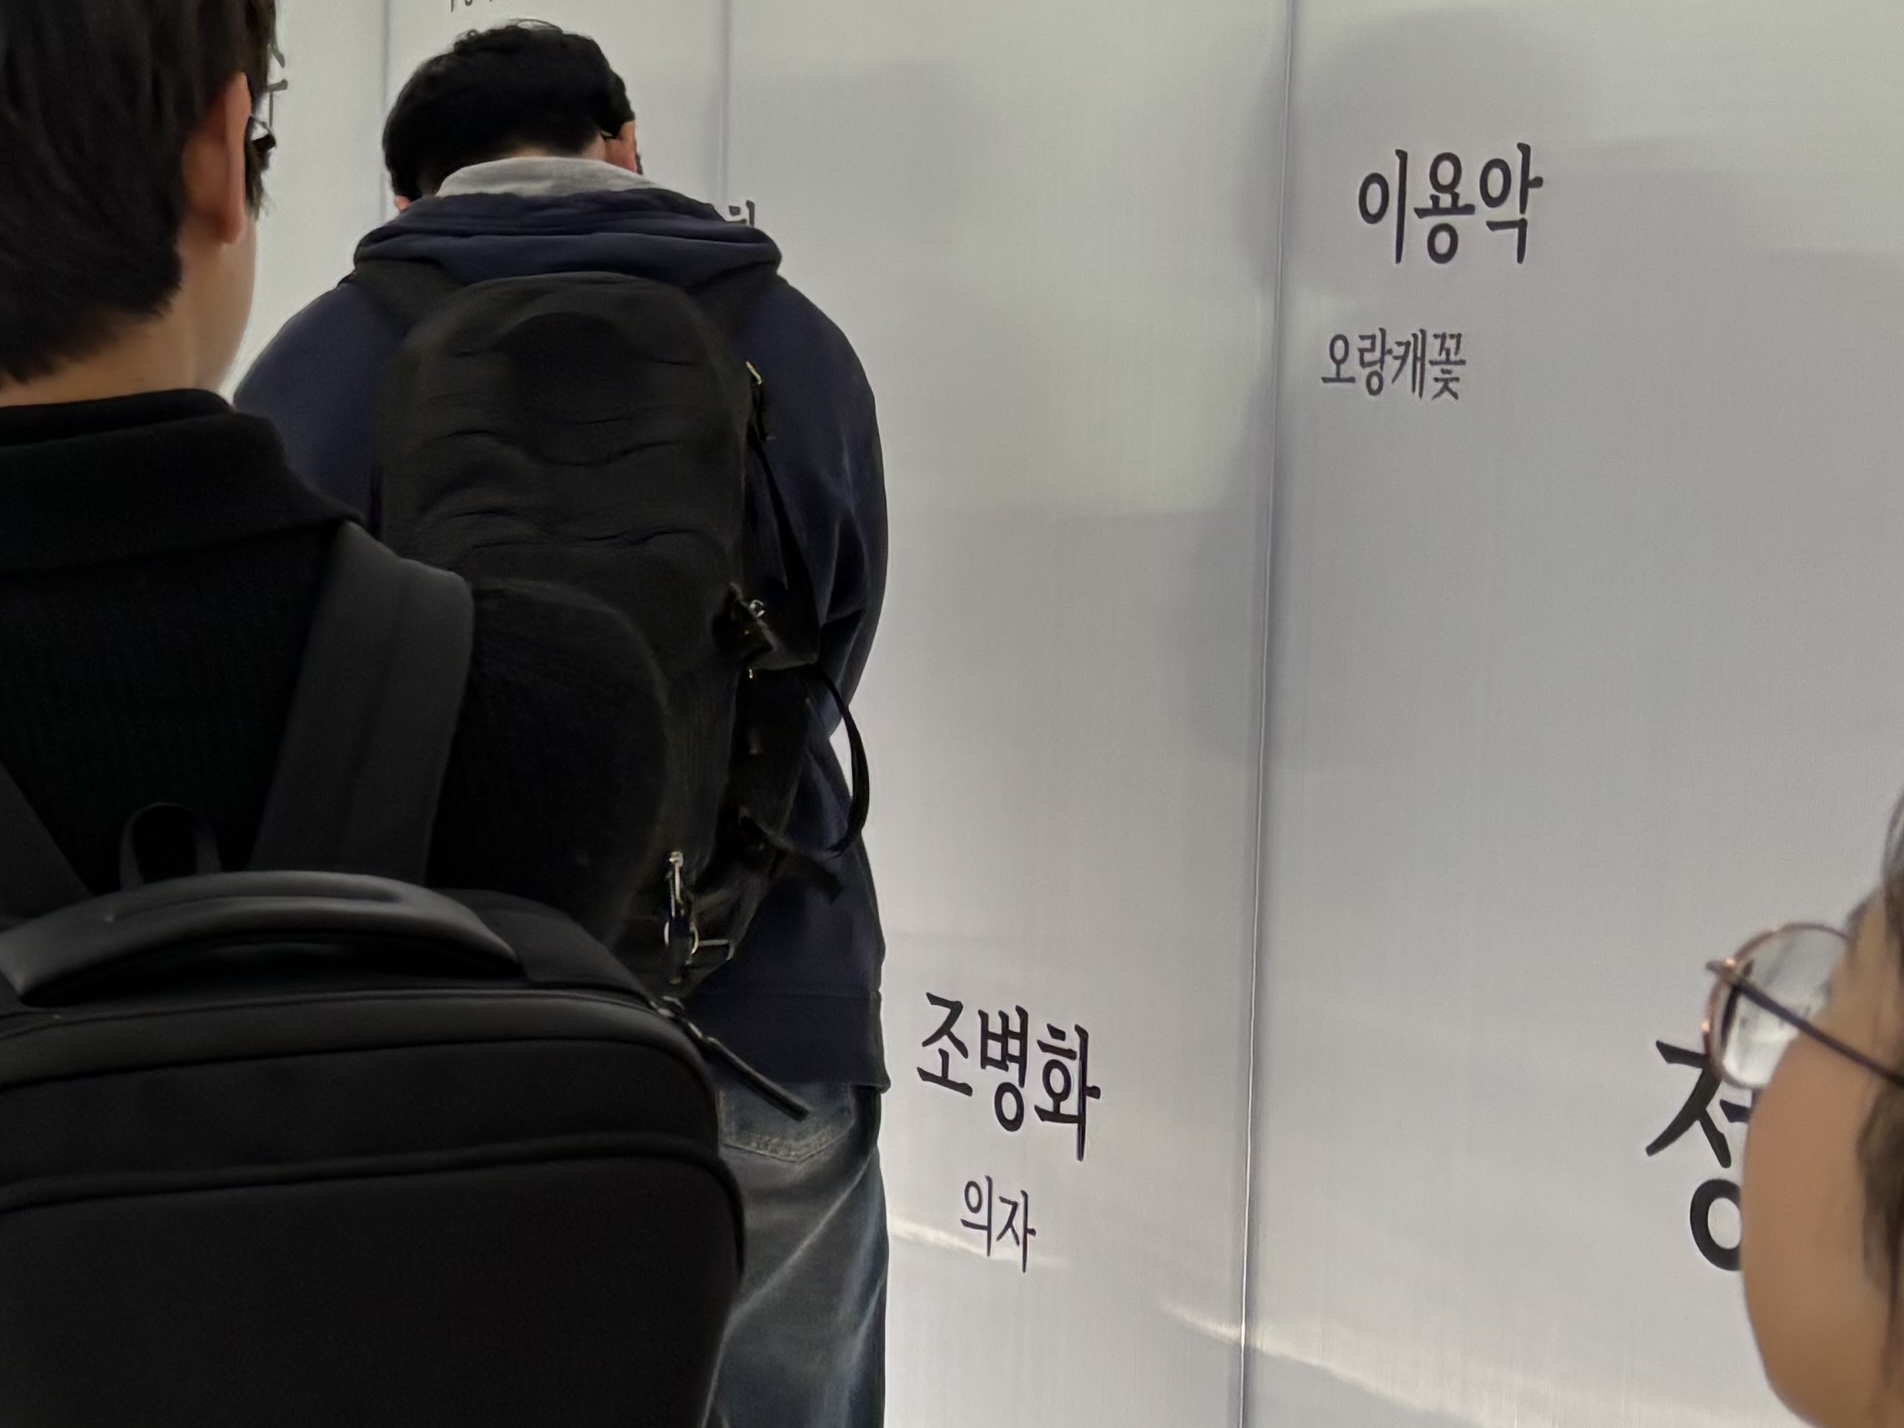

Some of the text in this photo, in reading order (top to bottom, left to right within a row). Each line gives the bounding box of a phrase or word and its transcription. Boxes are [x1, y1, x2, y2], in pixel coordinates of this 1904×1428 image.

[1357, 143, 1544, 264] 이용악
[1320, 327, 1467, 401] 오랑캐꽃
[915, 991, 1101, 1162] 조병화
[960, 1175, 1037, 1274] 의자
